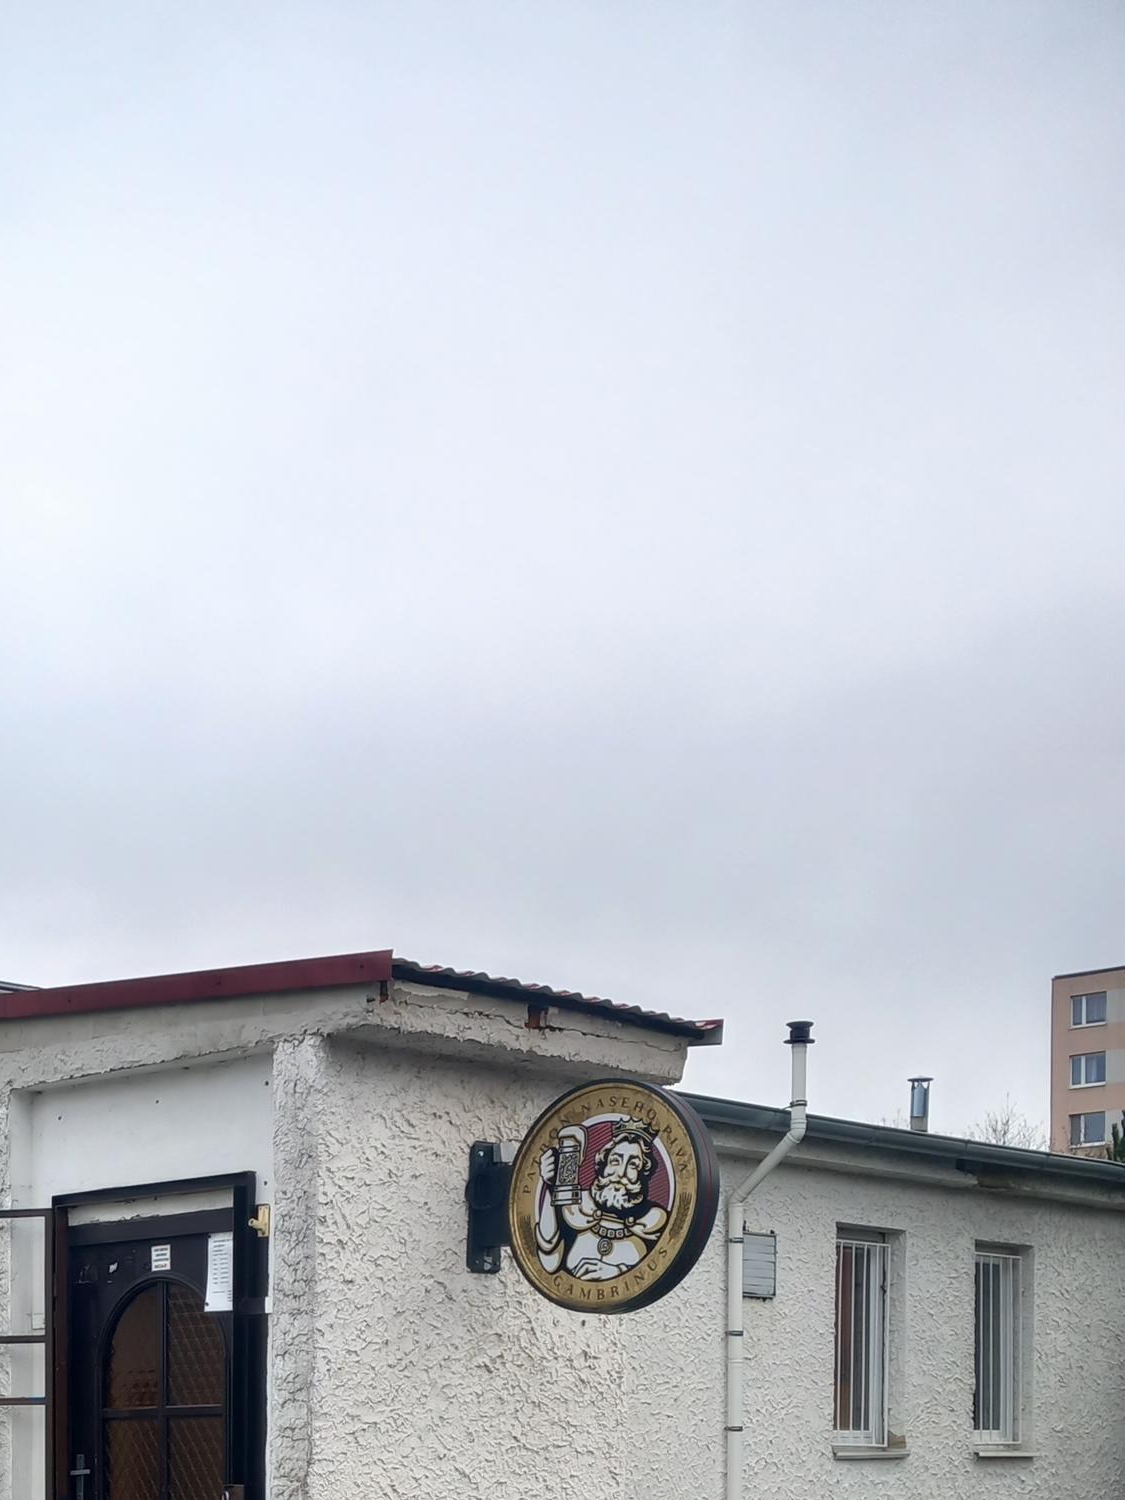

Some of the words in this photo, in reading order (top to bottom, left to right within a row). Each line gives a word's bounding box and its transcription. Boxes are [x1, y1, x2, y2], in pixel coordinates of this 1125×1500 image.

[523, 1115, 572, 1194] PATRON
[663, 1125, 688, 1172] PIVA
[553, 1247, 667, 1301] GAMBRINUS
